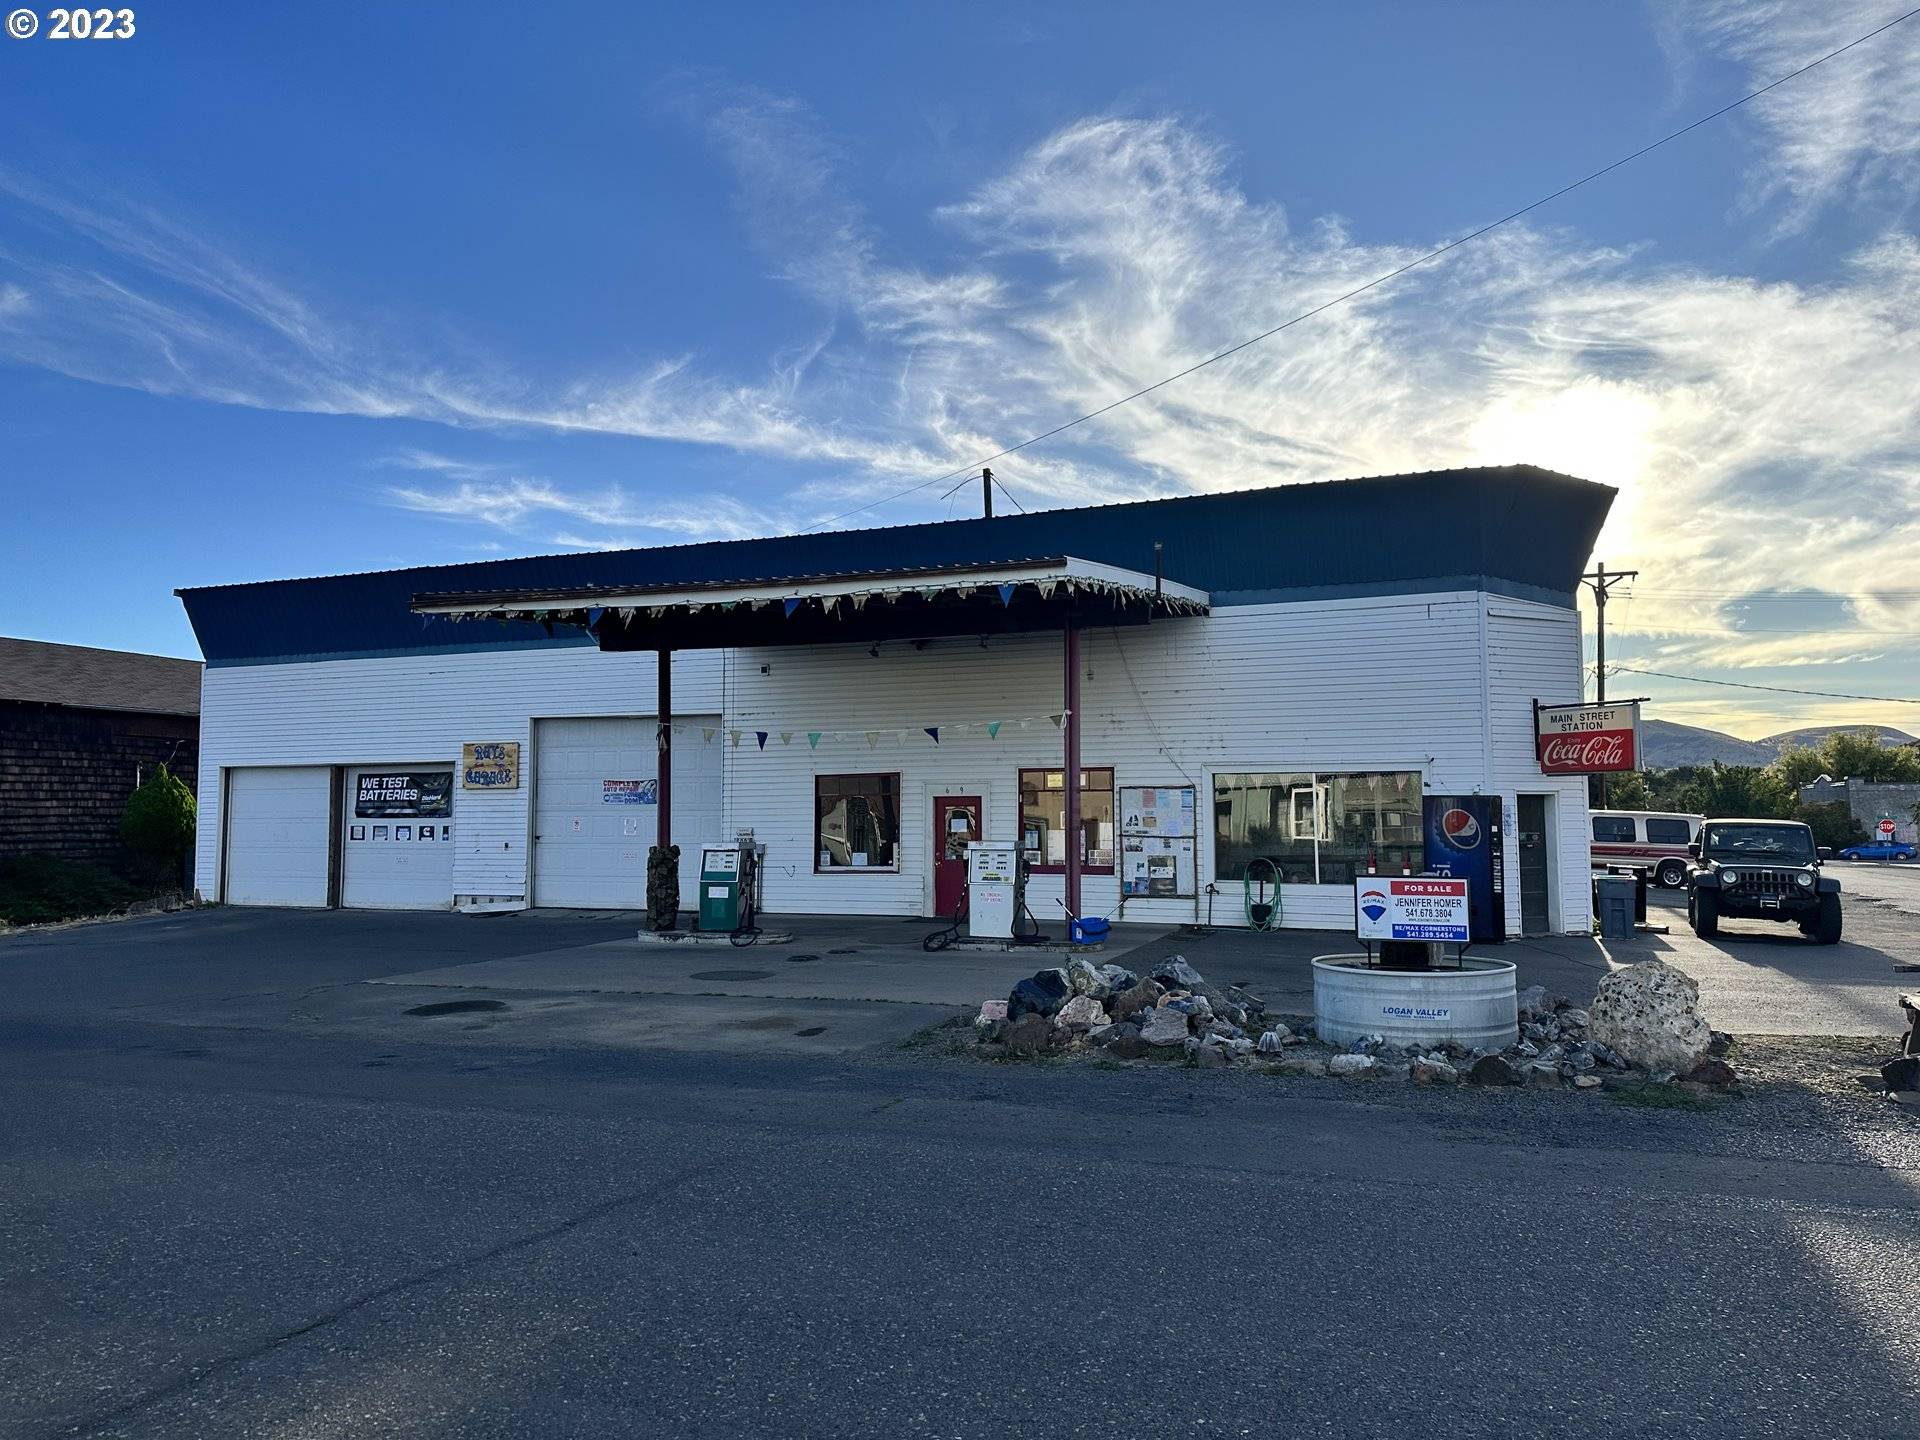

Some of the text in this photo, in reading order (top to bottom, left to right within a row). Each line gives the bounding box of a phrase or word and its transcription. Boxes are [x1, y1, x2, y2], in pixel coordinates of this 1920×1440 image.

[1550, 711, 1615, 723] MAIN STREET
[1561, 722, 1603, 732] STATION
[1543, 735, 1625, 767] Coca-Cola
[361, 777, 409, 788] WE TEST
[360, 789, 418, 801] BATTERIES
[1428, 885, 1452, 893] SALE
[1394, 898, 1462, 908] JENNIFER HOMER
[1405, 908, 1452, 918] 541.678.3804
[1420, 925, 1465, 933] CORNERSTONE
[1382, 1006, 1449, 1016] LOGAN VALLEY
